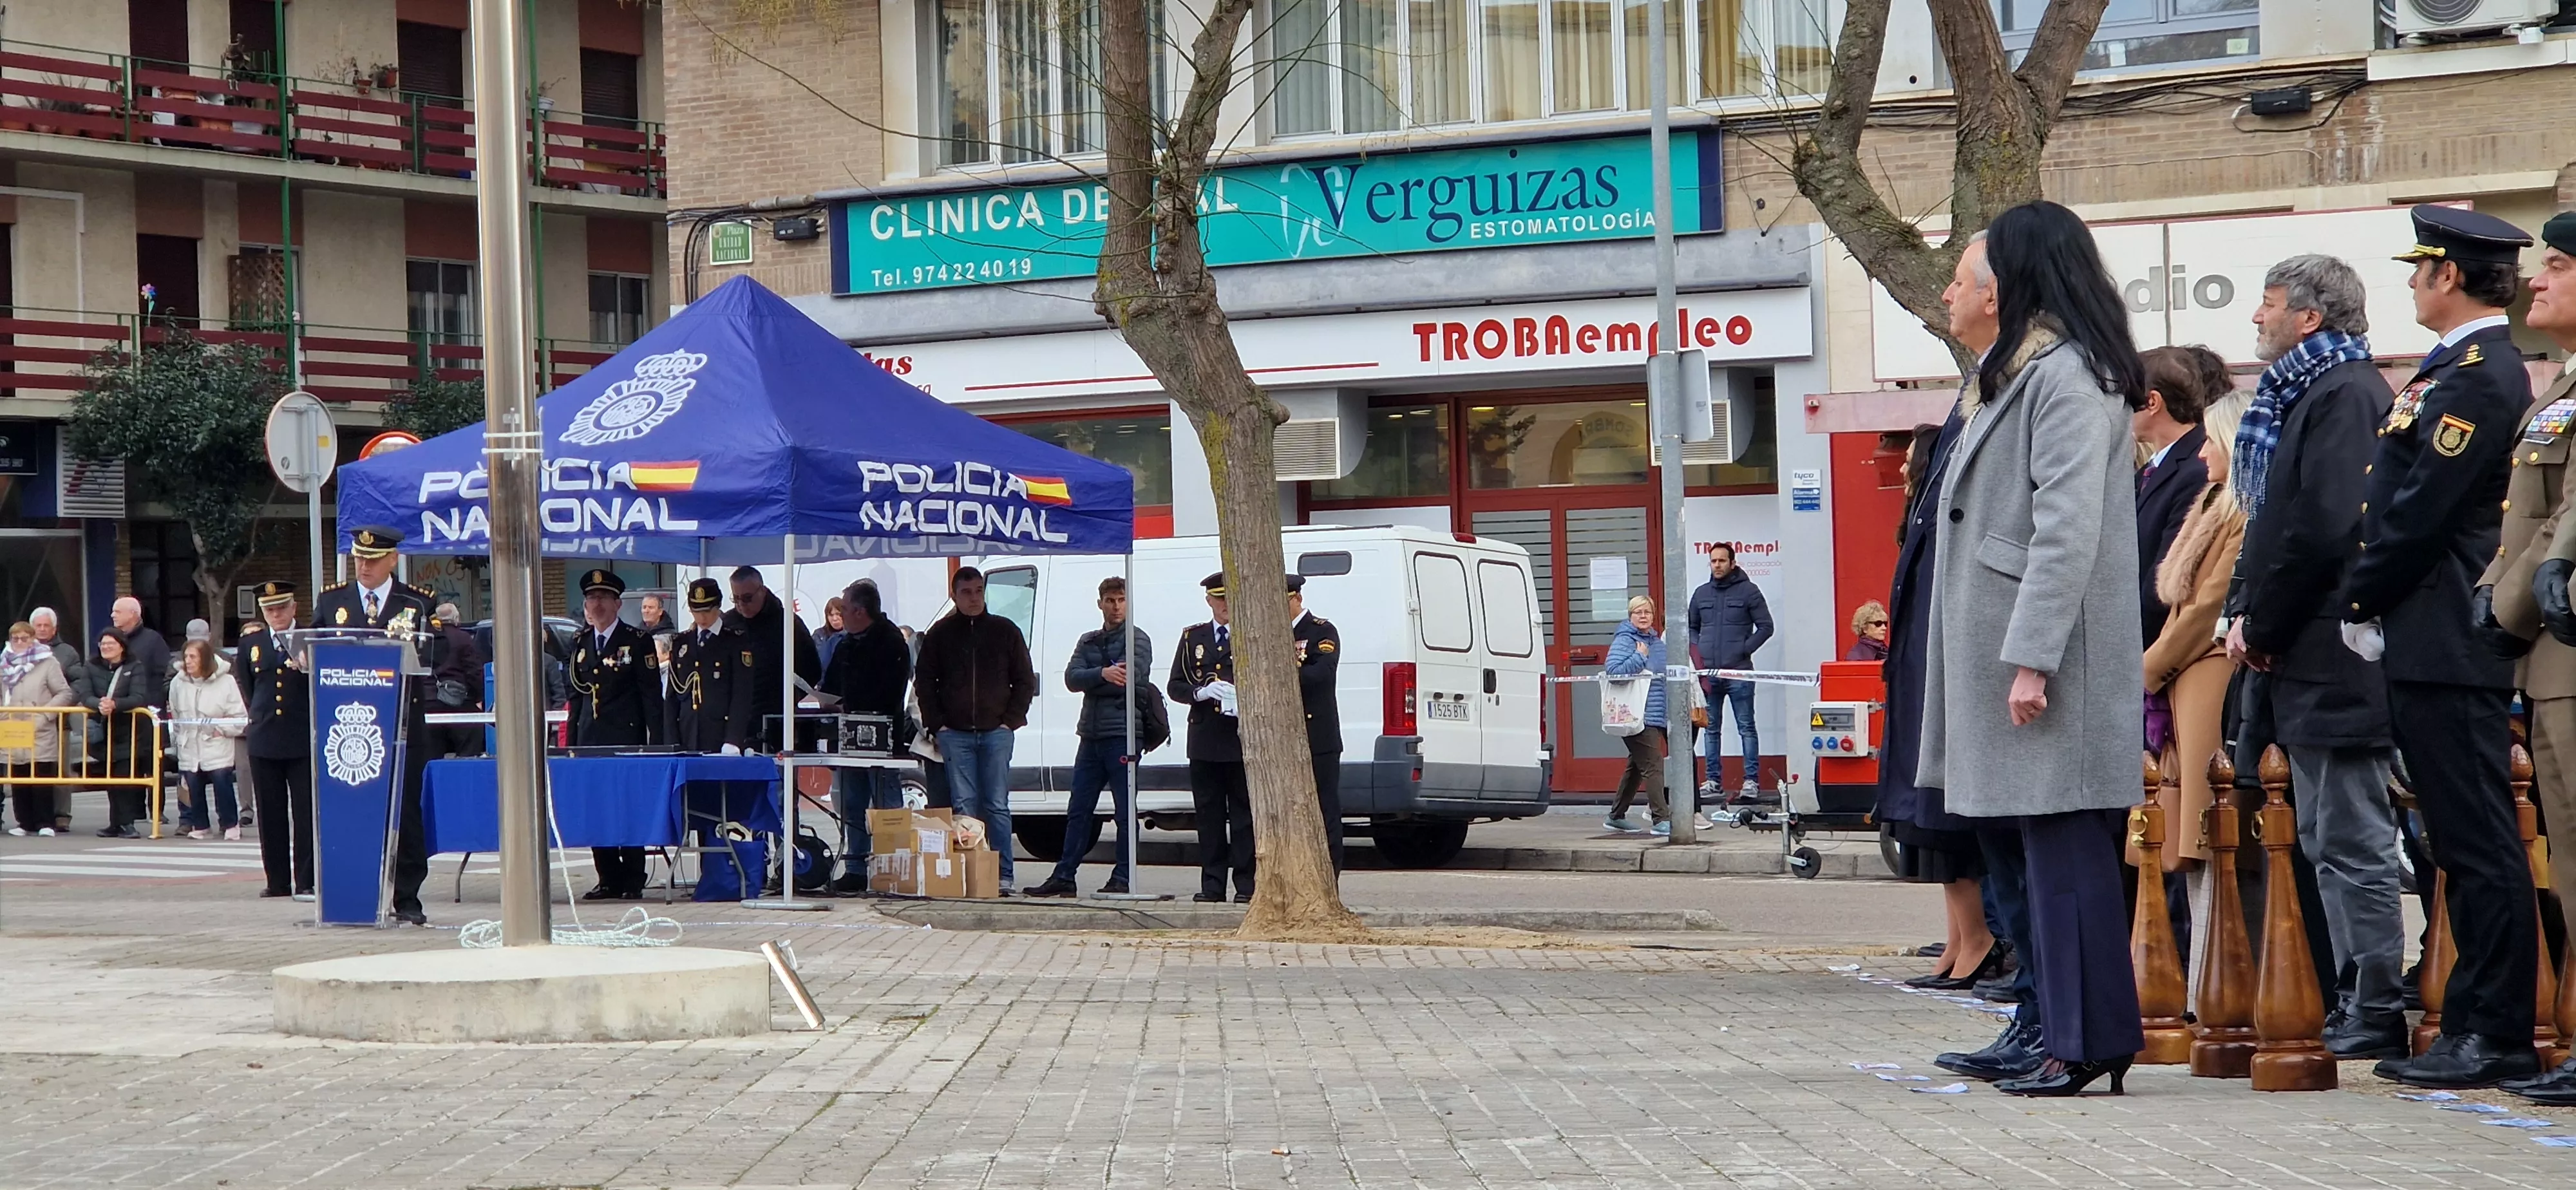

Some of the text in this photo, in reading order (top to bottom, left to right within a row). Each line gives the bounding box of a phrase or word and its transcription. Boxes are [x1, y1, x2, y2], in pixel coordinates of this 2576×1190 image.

[1308, 149, 1619, 243] Verguizas
[870, 191, 1045, 241] CLINICA
[1470, 207, 1656, 239] ESTOMATOLOGÍA
[727, 225, 744, 235] Plaza
[716, 249, 746, 261] NACIONAL
[871, 267, 907, 287] Tel.
[418, 458, 638, 504] POICIA
[857, 461, 1028, 500] POLICIA
[421, 497, 699, 543] NAONAL
[858, 499, 1068, 543] NACIONAL
[1694, 540, 1782, 556] TRAempl
[319, 668, 379, 677] POLICIA
[319, 677, 393, 686] NACIONAL
[1434, 703, 1468, 719] 1525 BTK
